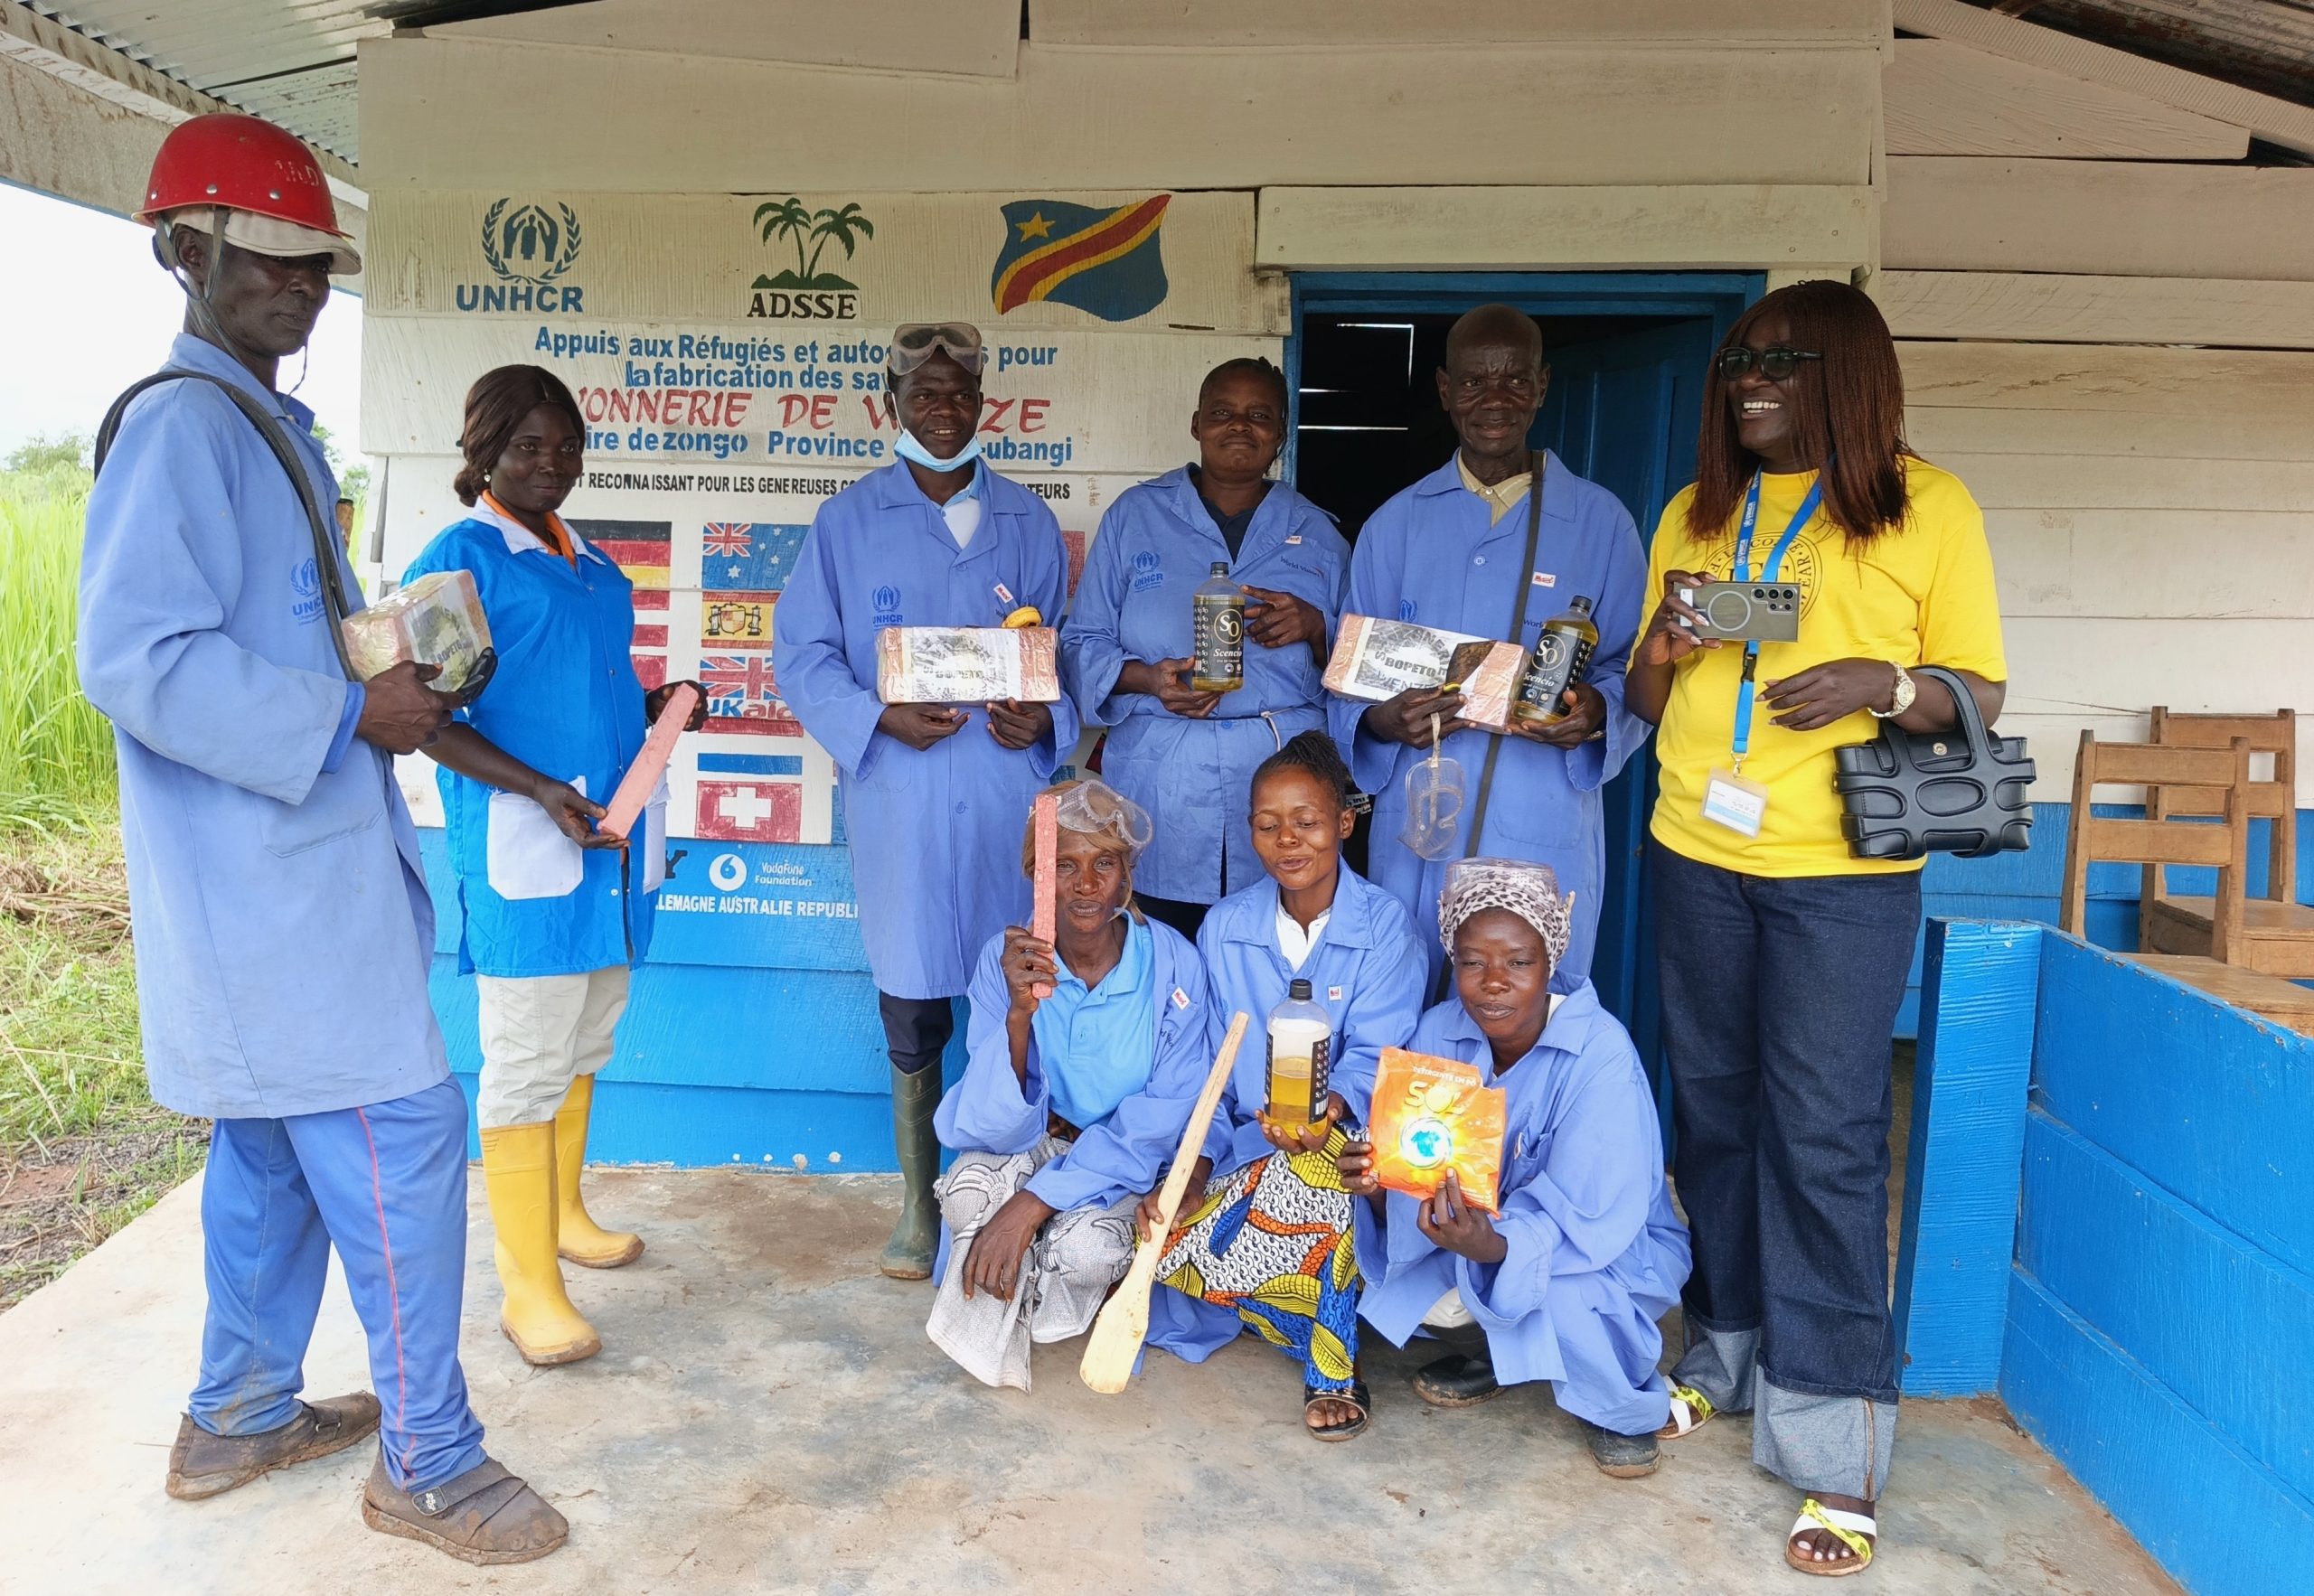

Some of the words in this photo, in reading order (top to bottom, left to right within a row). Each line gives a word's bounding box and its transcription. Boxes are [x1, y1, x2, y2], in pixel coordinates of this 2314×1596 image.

[456, 285, 584, 313] UNHCR
[747, 292, 858, 319] ADSSE
[535, 326, 620, 358] Appuis
[629, 333, 673, 358] aux
[679, 334, 786, 367] Réfugiés
[795, 340, 819, 363] et
[998, 345, 1058, 372] pour
[626, 361, 650, 388] la
[654, 362, 794, 389] fabrication
[799, 364, 843, 390] des
[778, 394, 838, 430] DE
[628, 427, 660, 451] de
[663, 434, 748, 459] zongo
[768, 430, 885, 458] Province
[697, 476, 730, 493] POUR
[733, 476, 755, 493] LES
[1134, 573, 1163, 587] UNHCR
[1385, 656, 1437, 678] BOPETO
[755, 874, 813, 887] Foundation
[656, 894, 716, 914] LEMAGNE
[720, 896, 793, 916] AUSTRALIE
[797, 900, 858, 920] REPUBLI
